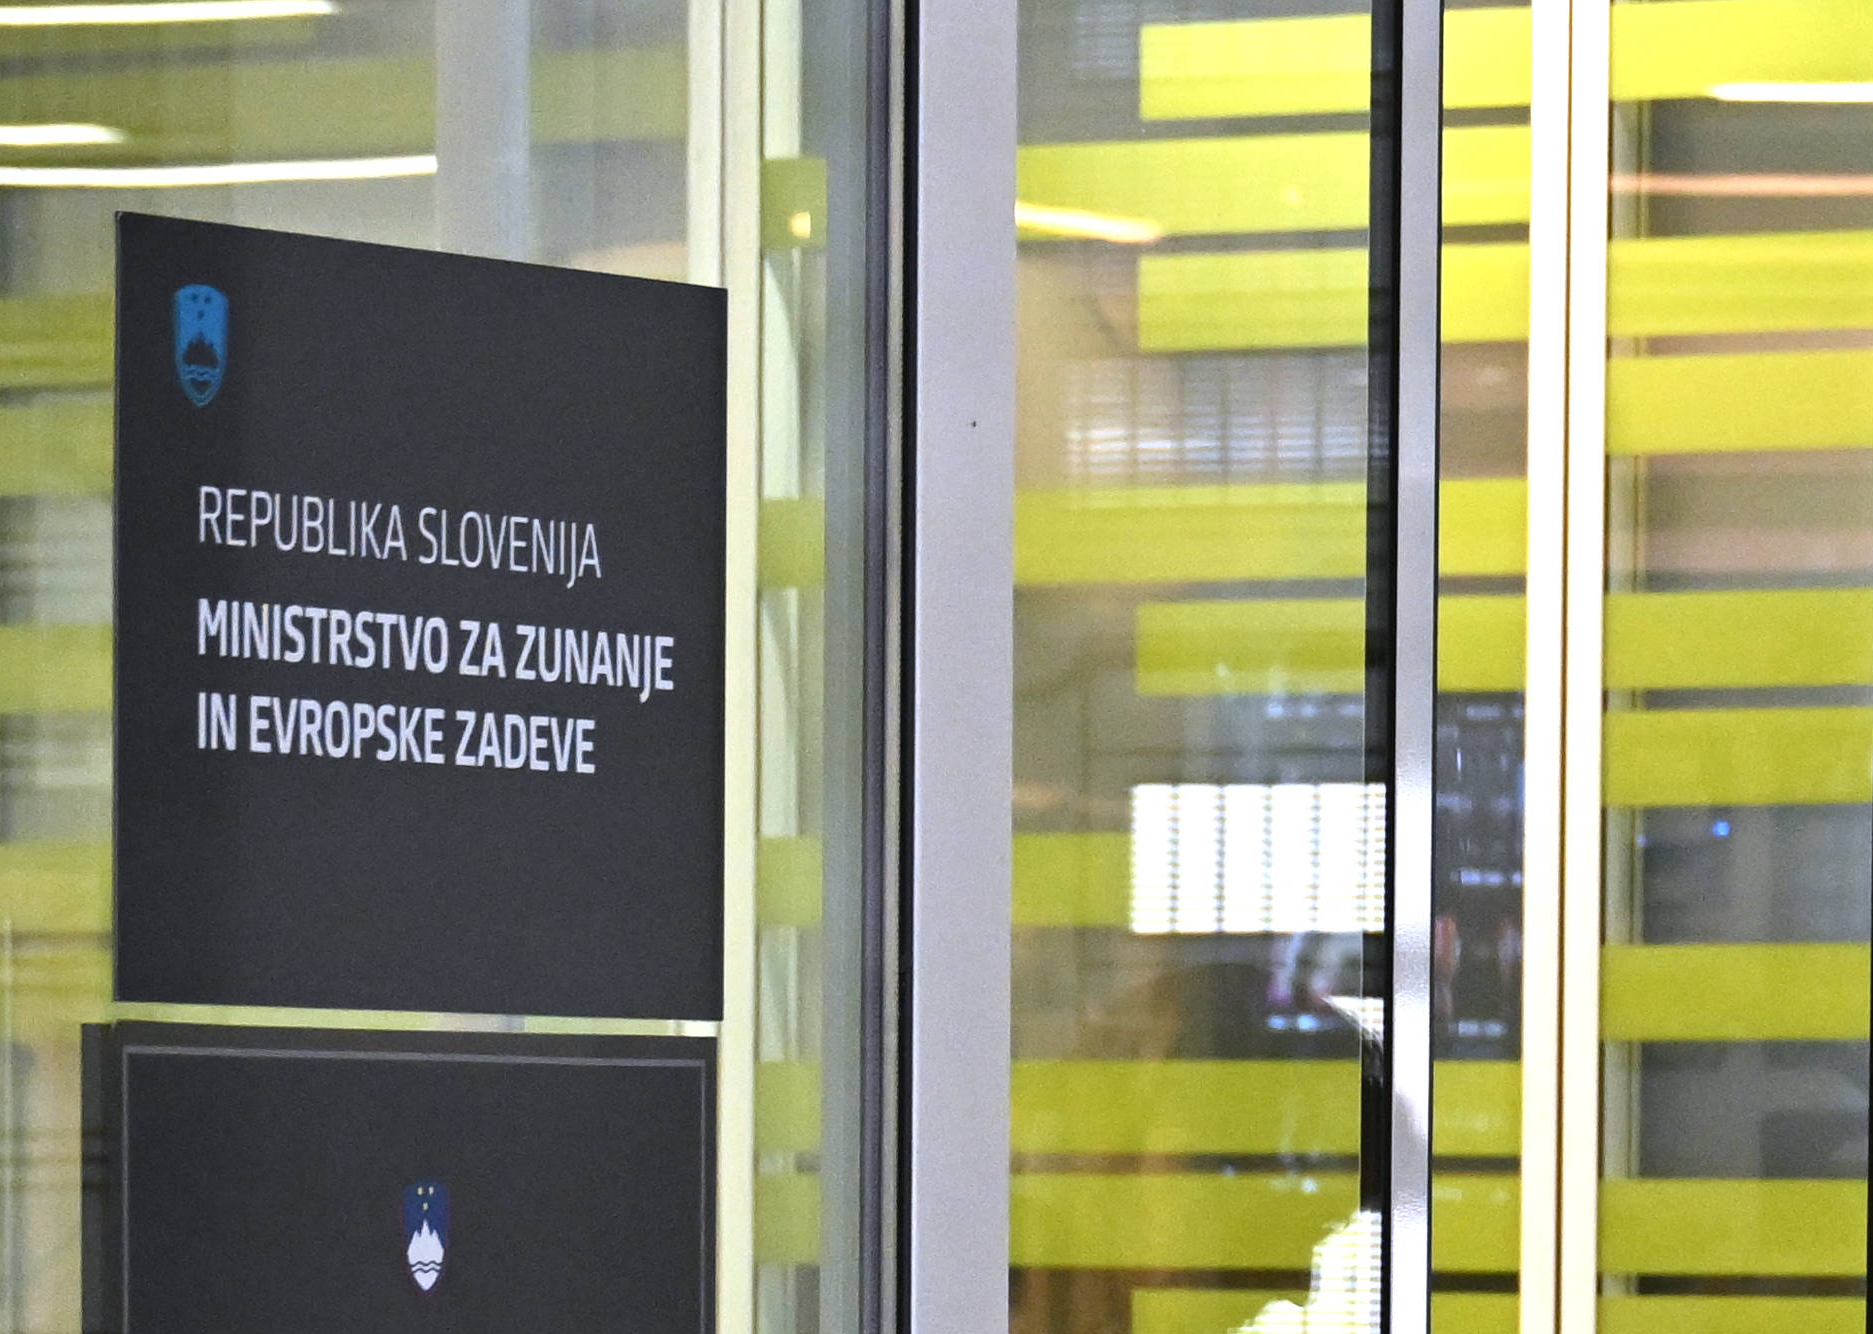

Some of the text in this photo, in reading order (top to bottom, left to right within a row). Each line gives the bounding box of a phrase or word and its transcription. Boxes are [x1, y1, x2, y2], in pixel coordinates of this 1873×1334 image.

[198, 485, 602, 589] REPUBLIKA SLOVENIJA
[197, 598, 675, 703] MINISTRSTVO ZA ZUNANJE
[197, 692, 596, 773] IN EVROPSKE ZADEVE
